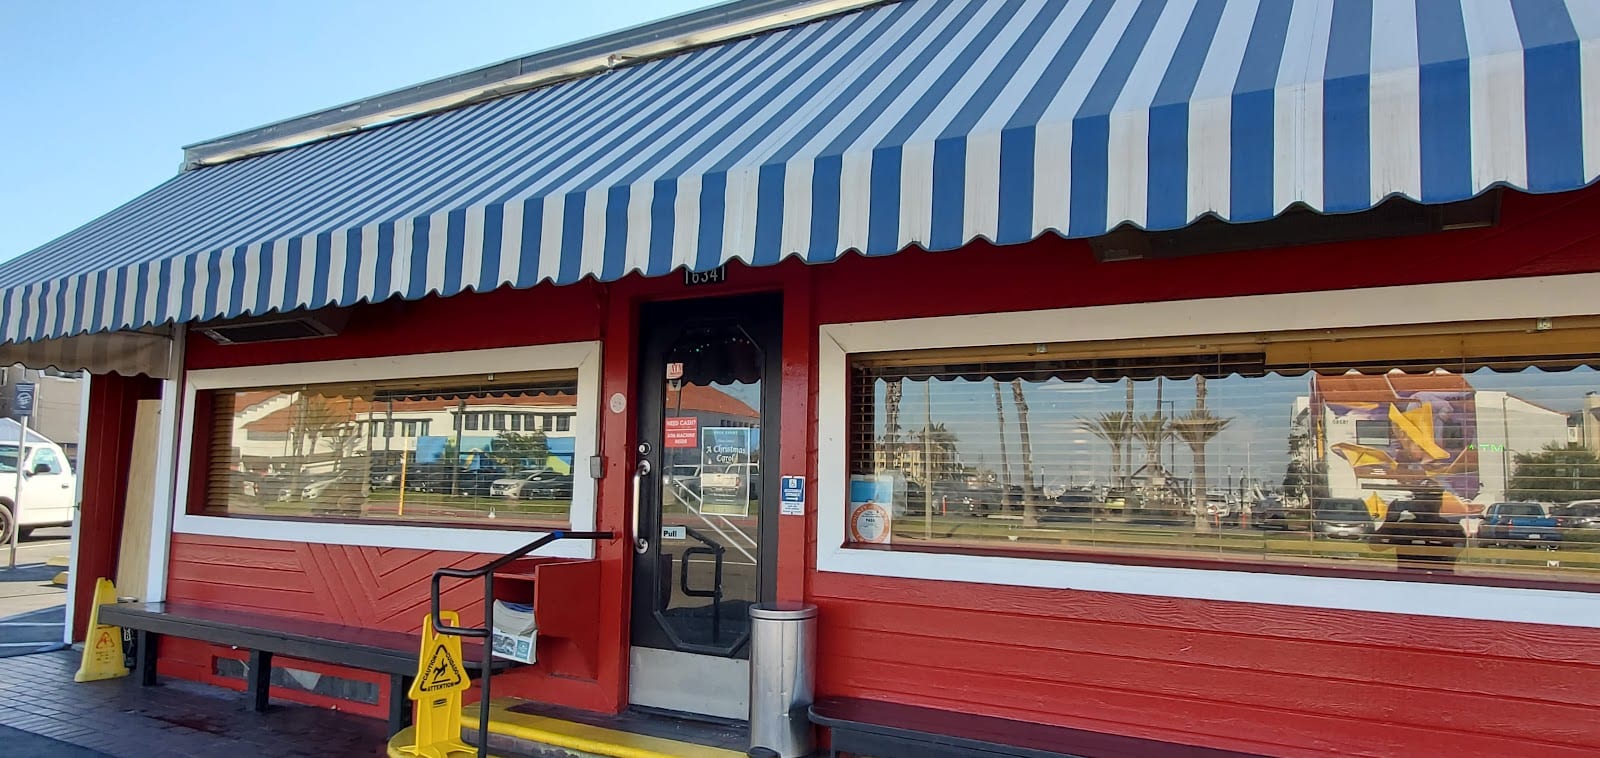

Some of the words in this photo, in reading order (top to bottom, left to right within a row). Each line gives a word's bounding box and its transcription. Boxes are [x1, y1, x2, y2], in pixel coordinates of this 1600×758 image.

[685, 265, 725, 285] 16341
[706, 446, 712, 454] A
[713, 445, 746, 454] Christmas
[423, 654, 437, 681] CAUTION
[427, 682, 454, 692] ATTENTION
